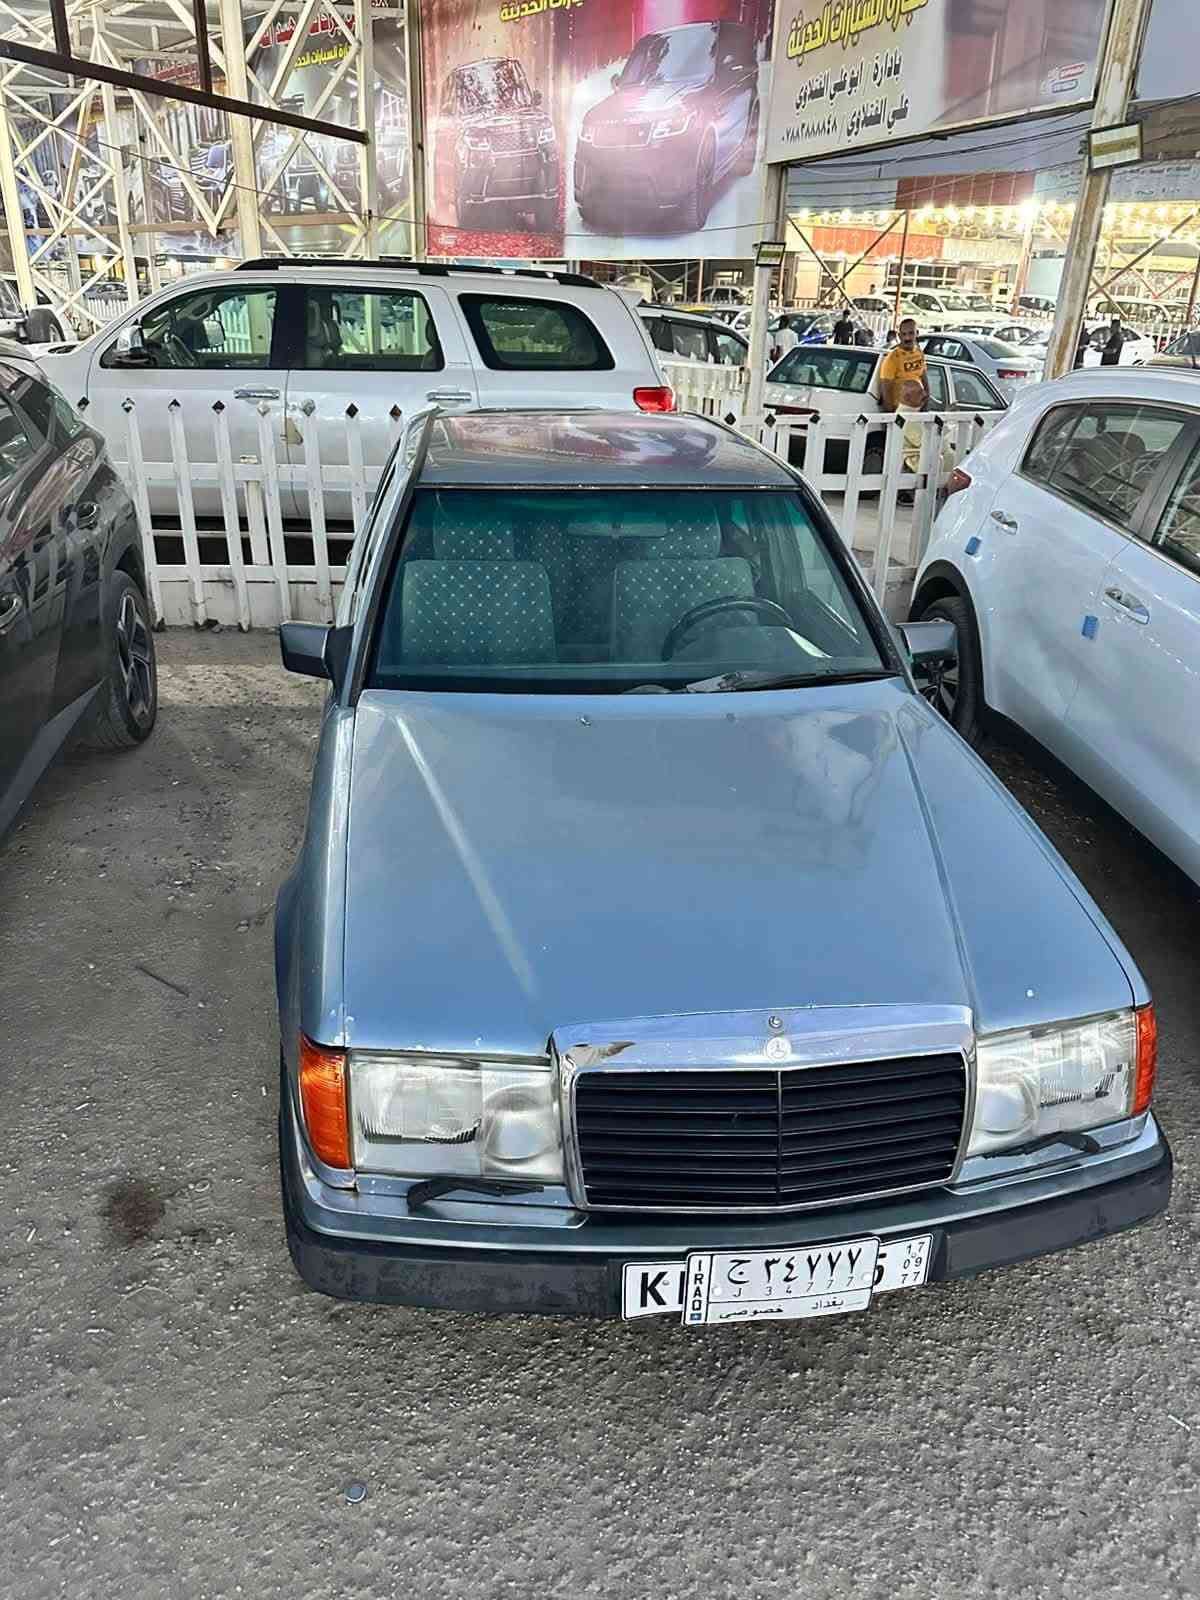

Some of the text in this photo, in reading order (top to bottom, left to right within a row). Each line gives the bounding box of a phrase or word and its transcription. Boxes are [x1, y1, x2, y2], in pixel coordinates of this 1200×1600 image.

[787, 2, 831, 66] الحديثة
[887, 94, 909, 134] علي
[692, 1259, 705, 1311] IRAQ
[728, 1248, 862, 1285] ٣٤٧٧٧ ج
[764, 1276, 855, 1297] 34777
[811, 1296, 844, 1310] بغداد
